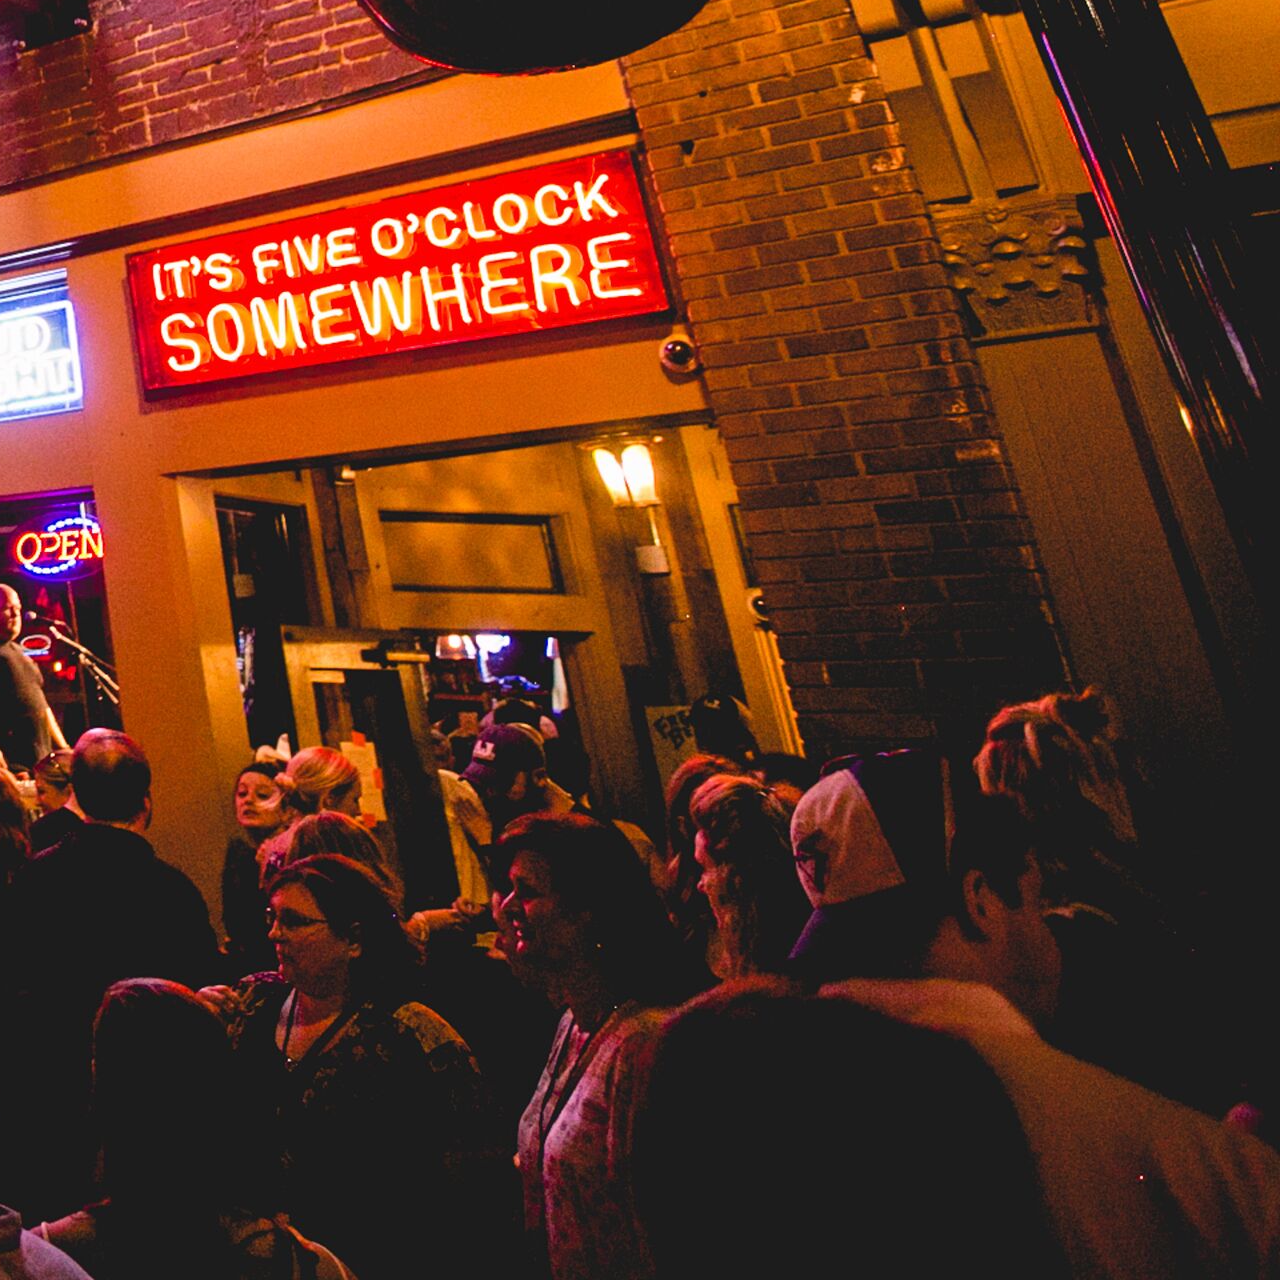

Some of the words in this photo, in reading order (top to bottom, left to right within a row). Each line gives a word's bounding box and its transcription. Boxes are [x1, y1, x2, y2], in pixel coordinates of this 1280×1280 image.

[150, 250, 236, 301] IT'S
[251, 226, 362, 284] FIVE
[370, 173, 620, 258] O'CLOCK
[159, 231, 643, 373] SOMEWHERE
[16, 529, 105, 566] OPEN
